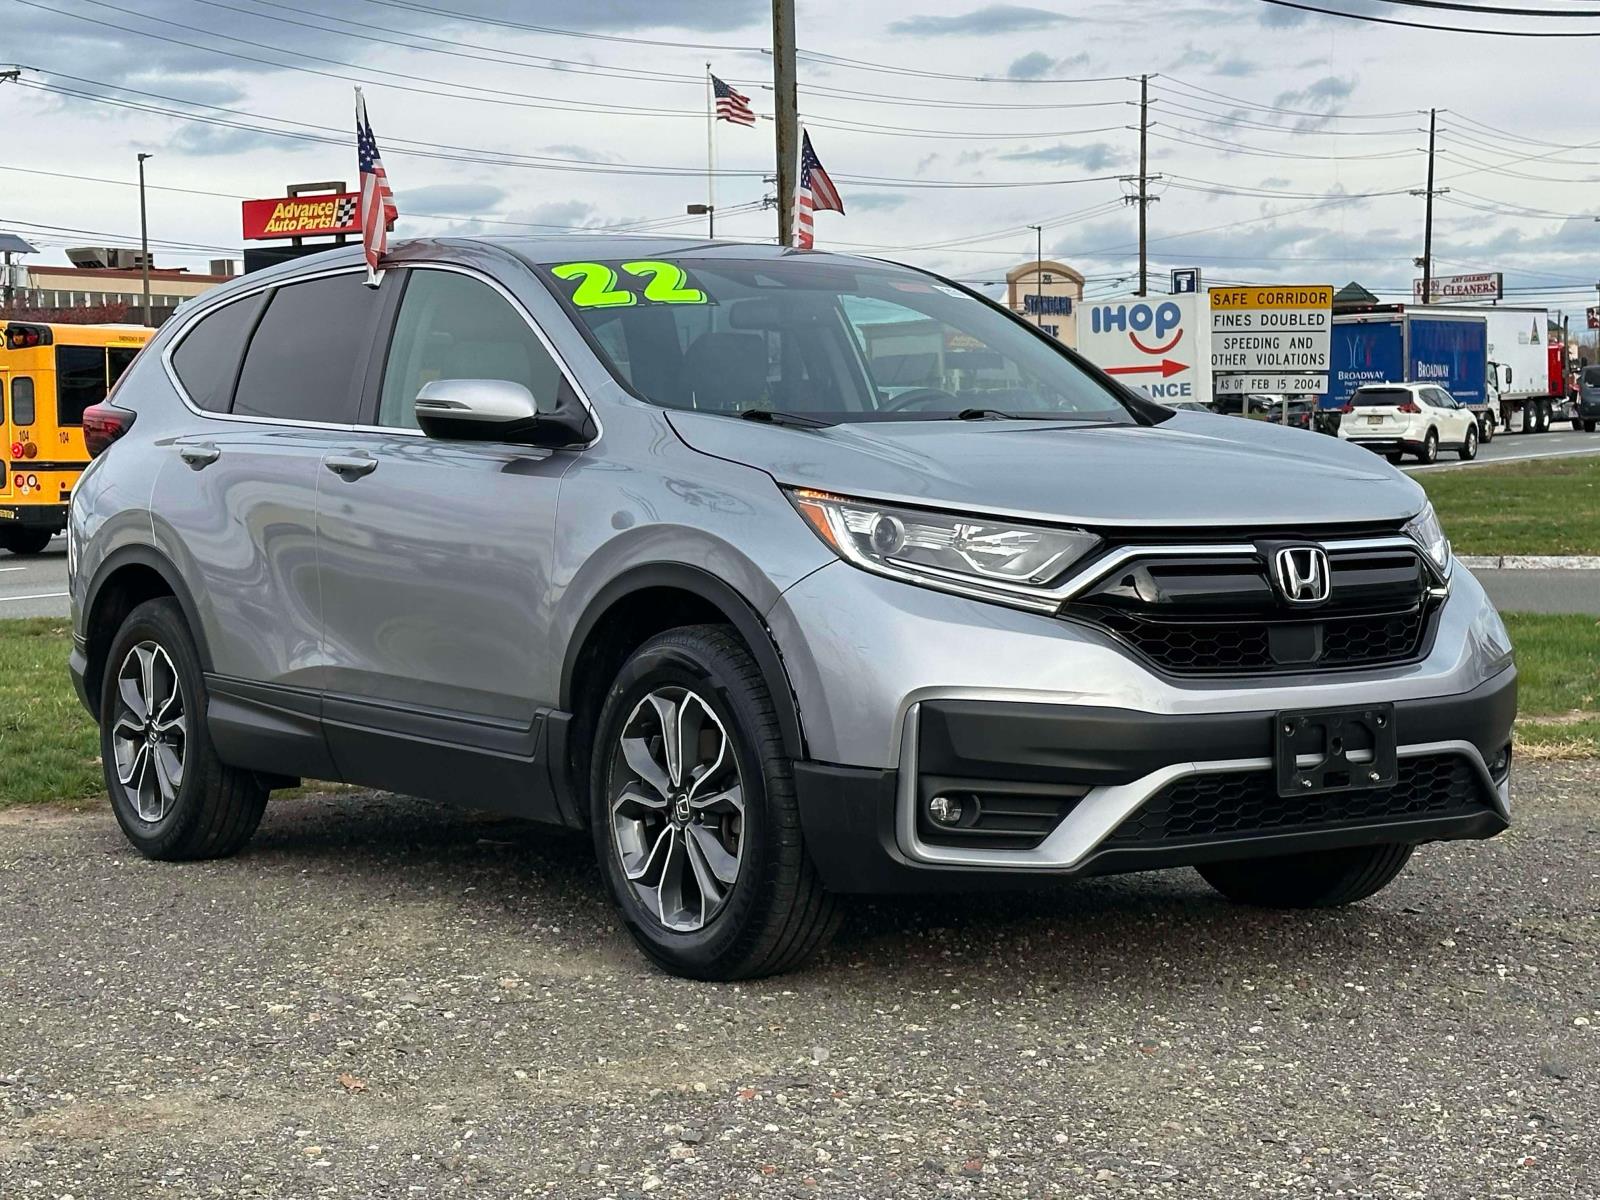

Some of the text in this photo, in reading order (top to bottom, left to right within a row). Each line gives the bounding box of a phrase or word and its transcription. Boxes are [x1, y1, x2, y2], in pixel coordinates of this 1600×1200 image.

[272, 202, 334, 218] Advance
[264, 215, 331, 232] Auto Parts
[551, 261, 707, 308] 22
[1443, 281, 1496, 296] CLEANERS
[1213, 291, 1328, 306] SAFE CORRIDOR
[1091, 301, 1182, 339] IHOP
[1214, 313, 1325, 327] FINES DOUBLED
[1224, 337, 1313, 350] SPEEDING AND
[1211, 353, 1325, 366] OTHER VIOLATIONS
[1338, 370, 1384, 380] BROADWAY
[1417, 360, 1449, 378] BROADWAY
[1220, 379, 1321, 390] AS OF FEB 15 2004
[19, 430, 29, 442] 104
[59, 431, 69, 444] 104
